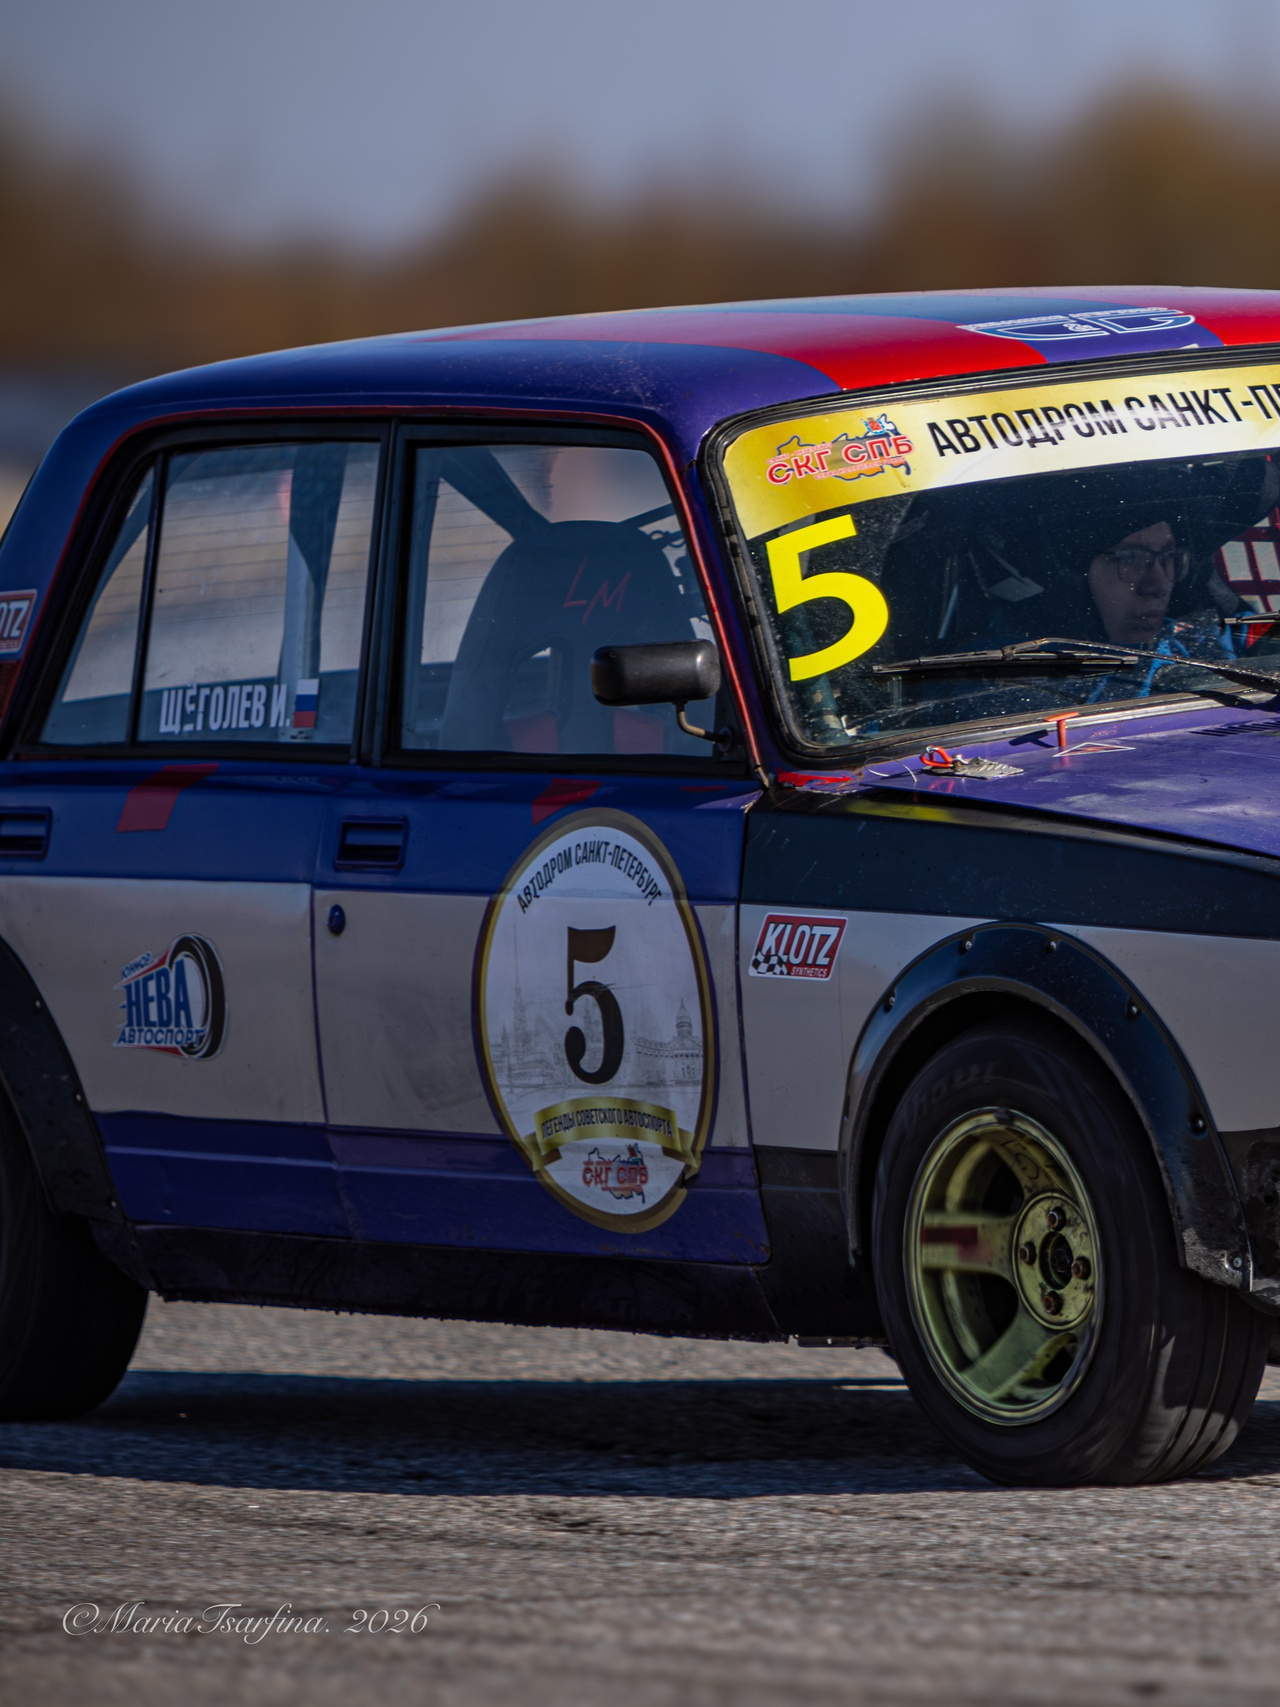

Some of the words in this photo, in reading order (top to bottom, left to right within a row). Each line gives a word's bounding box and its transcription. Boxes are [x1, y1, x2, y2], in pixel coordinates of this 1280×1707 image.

[927, 399, 1129, 457] АВТОДРОМ
[766, 447, 832, 486] СКГ
[842, 434, 914, 465] СПБ
[764, 514, 890, 683] 5
[517, 847, 573, 914] АВТОДРОМ
[574, 840, 662, 906] САНКТ-ПЕТЕРБУРГ
[761, 923, 840, 965] KLOTZ
[122, 958, 194, 1029] НЕВА
[564, 925, 625, 1085] 5
[117, 1028, 206, 1045] АВТОСПОРТ
[541, 1113, 575, 1140] ЛЕГЕНДЫ
[576, 1107, 623, 1126] СОВЕТСКОГО
[623, 1109, 674, 1139] АВТОСПОРТА
[616, 1165, 649, 1186] СПБ
